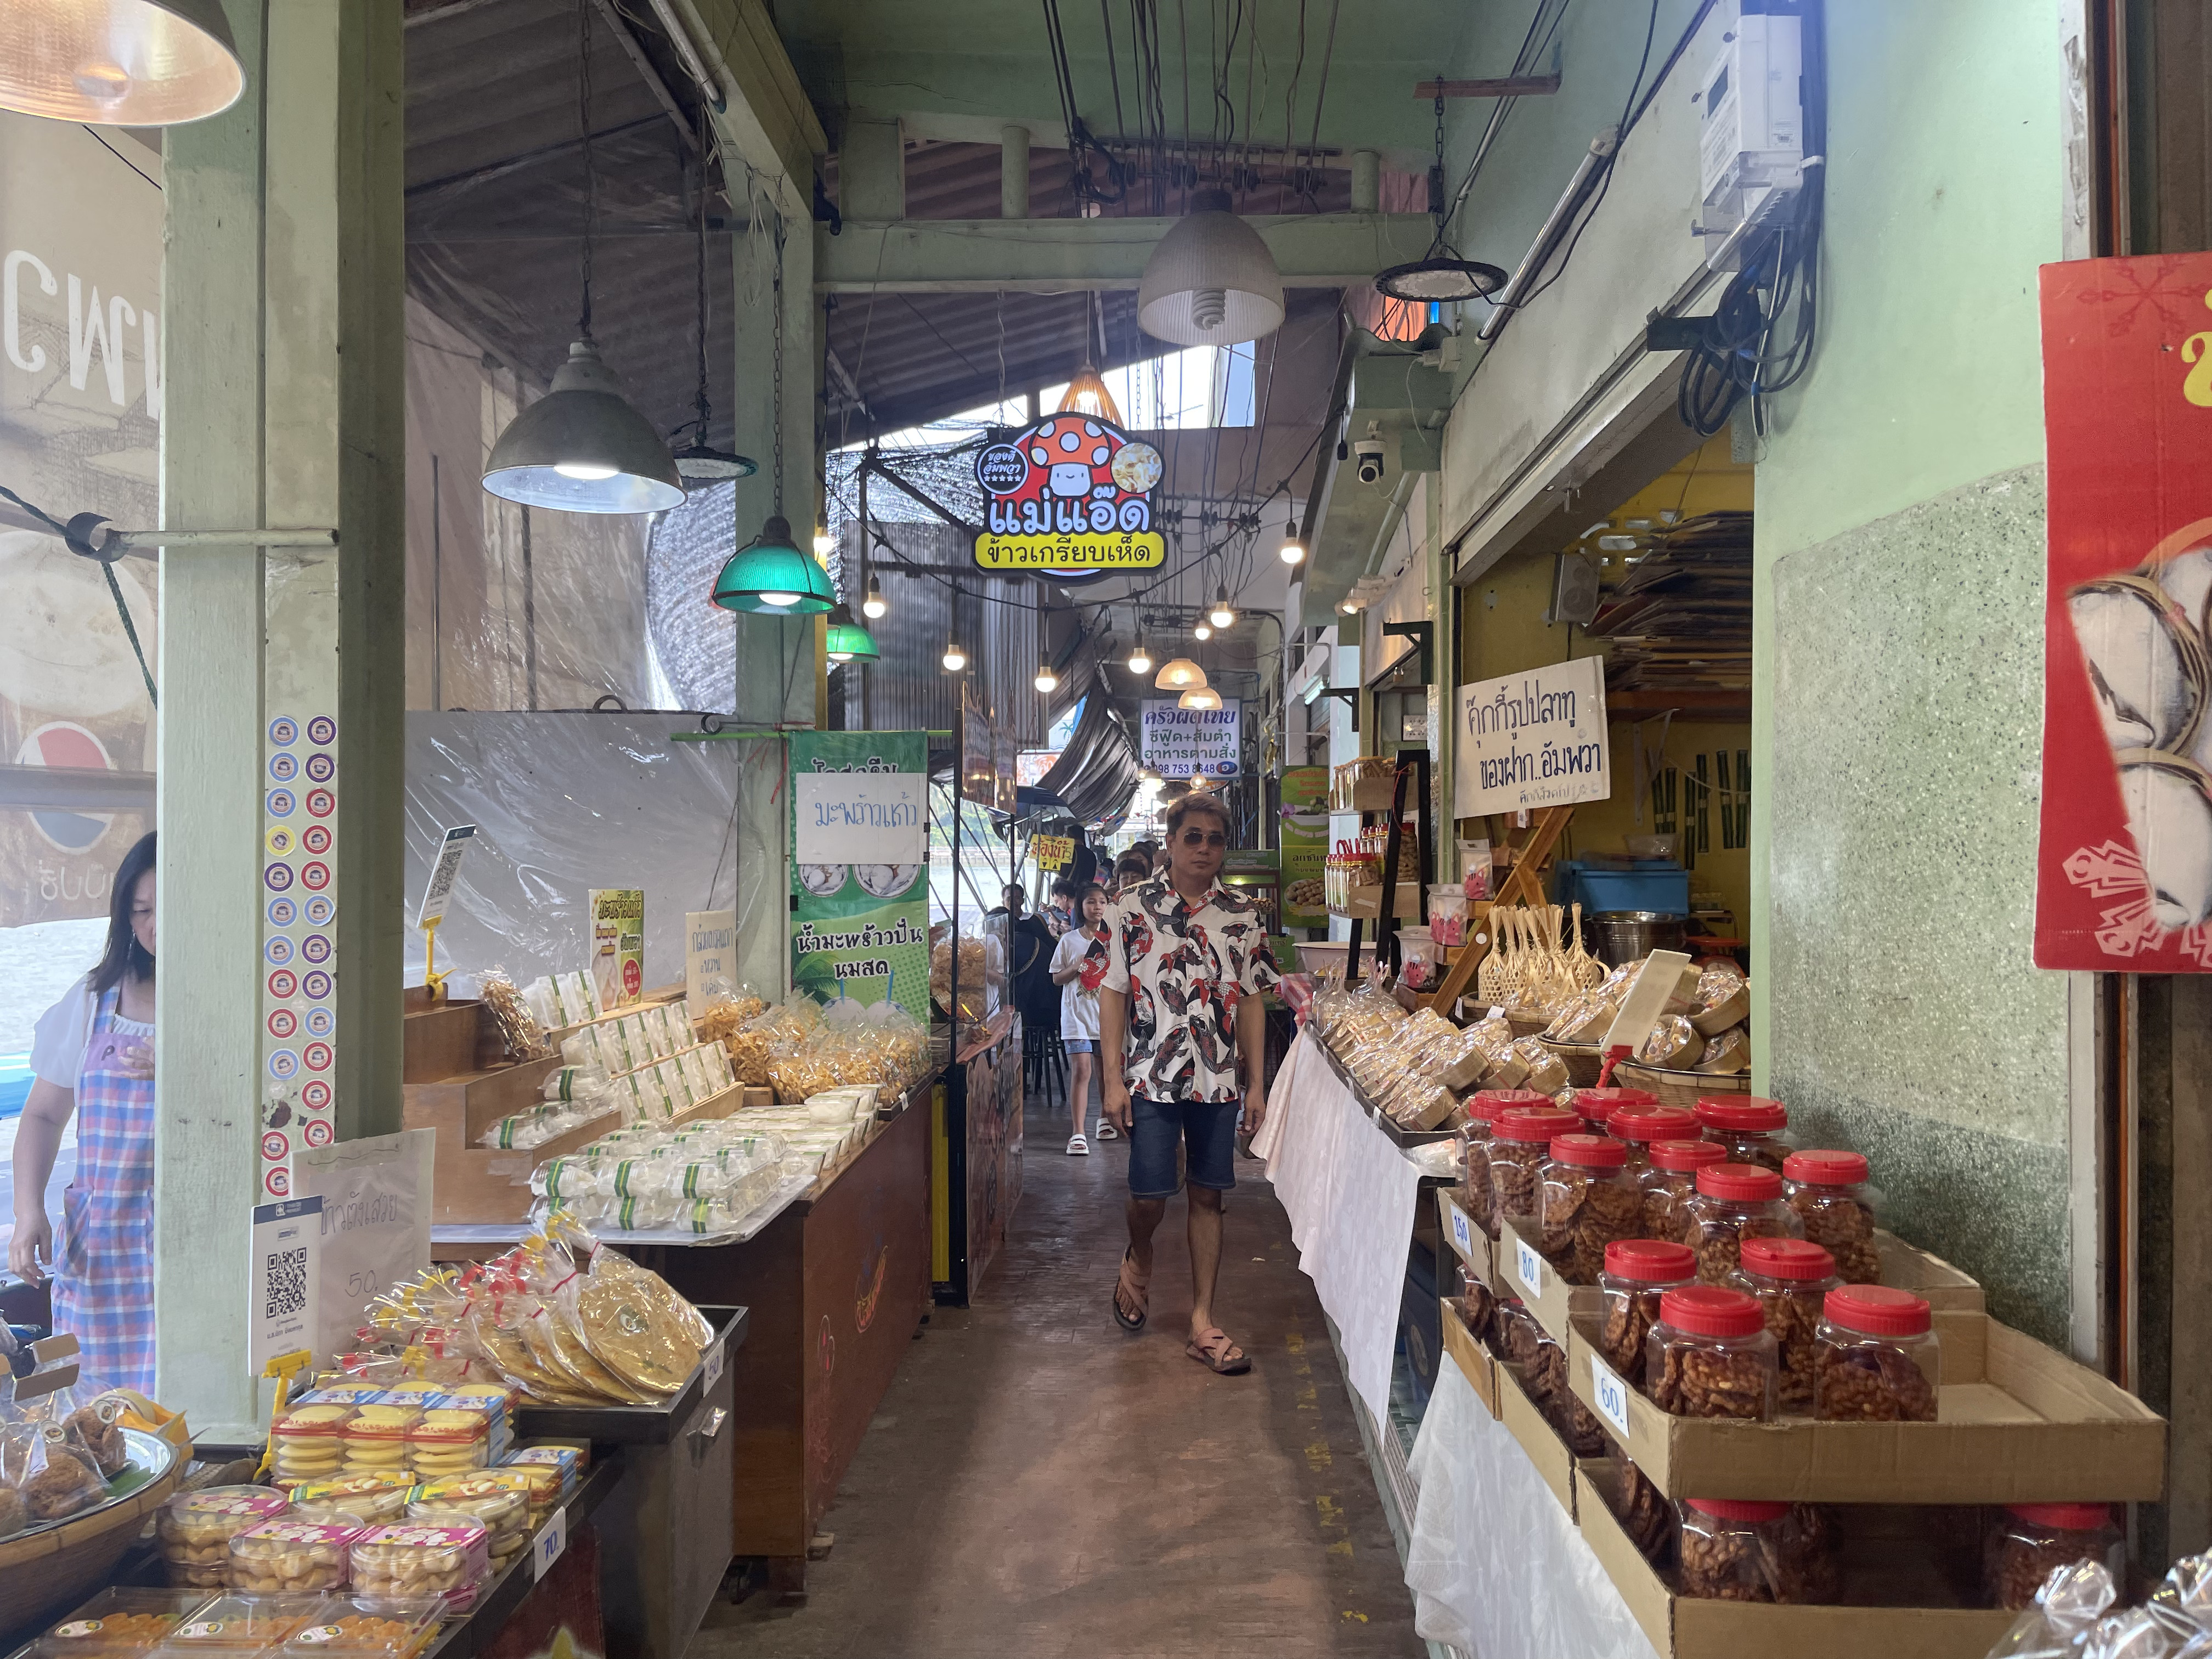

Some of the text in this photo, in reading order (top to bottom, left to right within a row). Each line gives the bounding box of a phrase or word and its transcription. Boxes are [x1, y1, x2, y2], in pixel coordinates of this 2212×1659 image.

[988, 449, 1016, 463] ของดี
[983, 461, 1022, 475] อัมพวา
[990, 485, 1149, 533] แม่แอ๊ด
[988, 534, 1150, 563] ข้าวเกรียบเห็ด
[1145, 705, 1236, 725] ครัวผดไทย
[1144, 743, 1236, 759] อาหารตามสั่ง
[1172, 764, 1189, 774] 753
[815, 791, 917, 827] มะพร้าวแก้ว
[798, 918, 923, 952] น้ำมะพร้าวปั่น
[834, 958, 889, 978] นมสด
